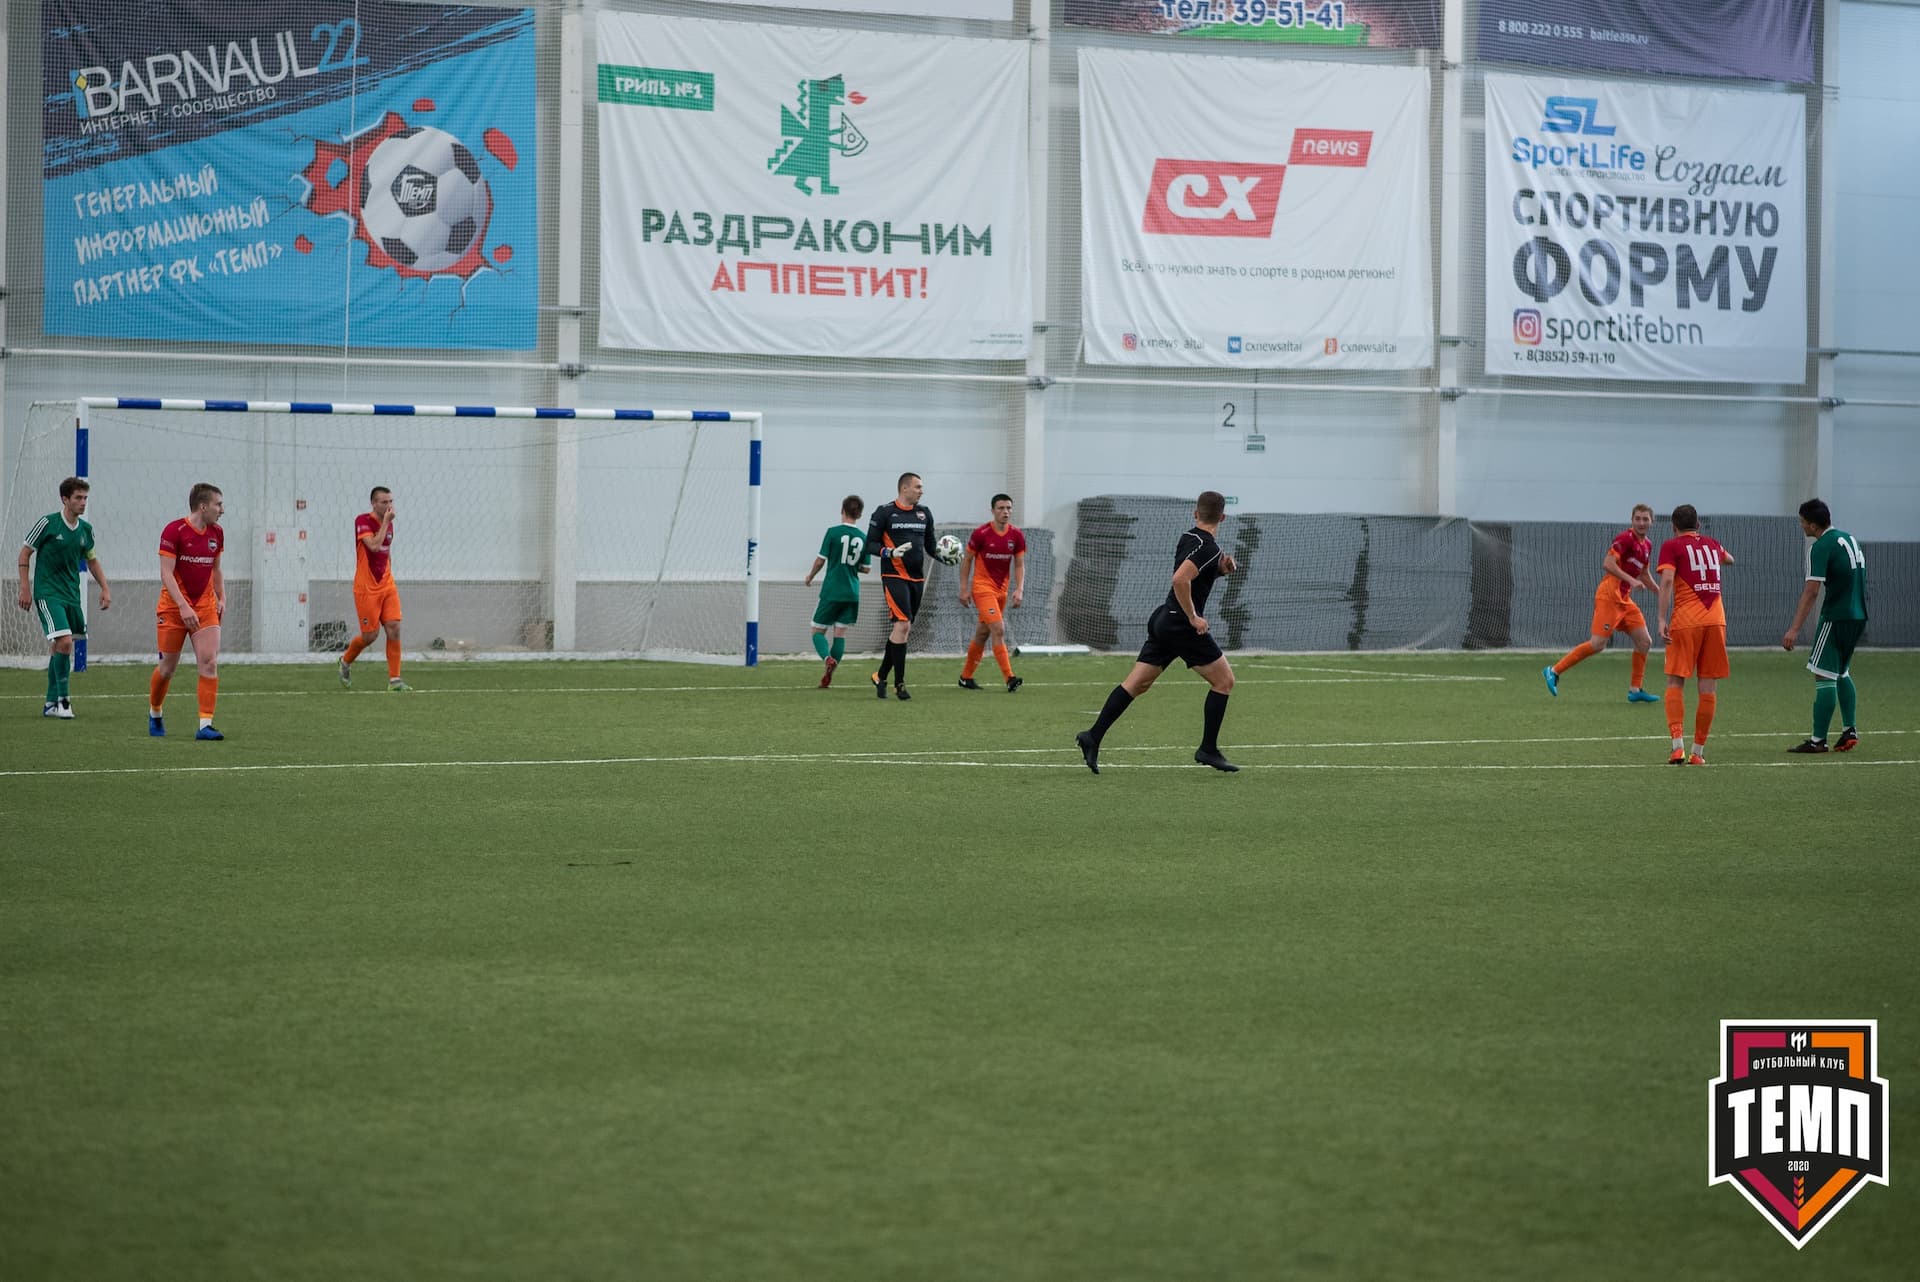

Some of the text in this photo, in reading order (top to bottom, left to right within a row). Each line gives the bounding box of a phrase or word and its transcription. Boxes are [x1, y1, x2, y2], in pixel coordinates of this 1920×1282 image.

[1232, 0, 1345, 29] 39-51-41
[1498, 20, 1505, 32] 8
[1508, 21, 1528, 33] 800
[1531, 23, 1550, 36] 222
[1553, 24, 1561, 37] 0
[1562, 26, 1583, 39] 555
[615, 77, 704, 99] ГРИЛЬ №1
[80, 108, 159, 135] ИНТЕРНЕТ
[171, 86, 276, 119] СООБЩЕСТВО
[1540, 96, 1617, 137] SL
[1302, 137, 1360, 157] news
[1512, 137, 1646, 171] SportLife
[1654, 144, 1788, 197] Создаем
[73, 163, 219, 220] ГЕНЕРАЛЬНЫЙ
[74, 195, 270, 265] ИНФОРМАЦИОННЫЙ
[1512, 188, 1780, 238] СПОРТИВНУЮ
[641, 208, 992, 257] РАЗДРАКОНИМ
[73, 240, 284, 306] ПАРТНЕР ФК «ТЕМП»
[711, 259, 928, 299] АППЕТИТ!
[1168, 263, 1204, 277] нужно
[1207, 265, 1238, 276] знать
[1250, 266, 1288, 279] спорте
[1301, 267, 1346, 280] родном
[1348, 267, 1395, 280] регионе!
[1512, 235, 1779, 313] ФОРМУ
[1546, 313, 1704, 348] sportlifebrn
[1526, 350, 1570, 364] 8(3852)
[1571, 351, 1616, 364] 59-11-10
[1222, 402, 1235, 428] 2
[840, 534, 865, 567] 13
[1686, 544, 1720, 581] 44
[1837, 535, 1865, 570] 14
